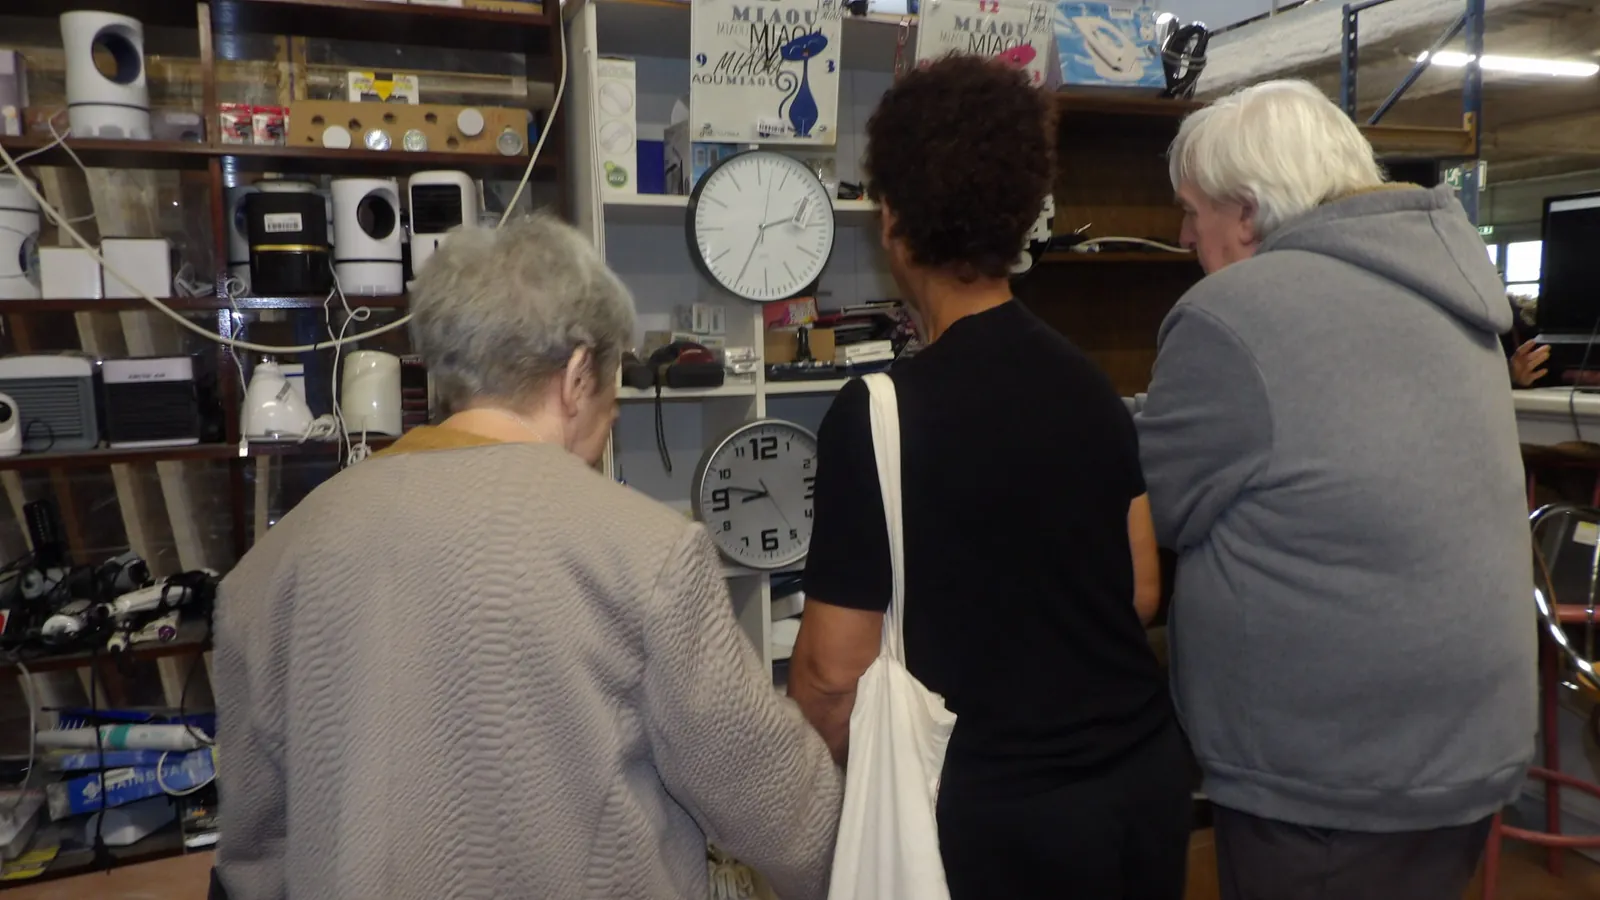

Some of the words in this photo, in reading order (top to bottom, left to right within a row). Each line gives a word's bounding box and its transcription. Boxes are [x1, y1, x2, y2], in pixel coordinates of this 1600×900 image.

[979, 0, 999, 14] 12
[731, 5, 817, 26] MIAOU
[695, 53, 707, 68] 9
[825, 59, 836, 73] 3
[691, 73, 723, 85] AOU
[734, 446, 745, 458] 11
[749, 436, 778, 461] 12
[785, 441, 790, 452] 1
[803, 459, 811, 469] 2
[718, 468, 732, 481] 10
[712, 487, 730, 513] 9
[805, 508, 813, 519] 4
[723, 521, 731, 531] 8
[761, 528, 778, 552] 6
[790, 529, 797, 540] 5
[741, 536, 749, 547] 7
